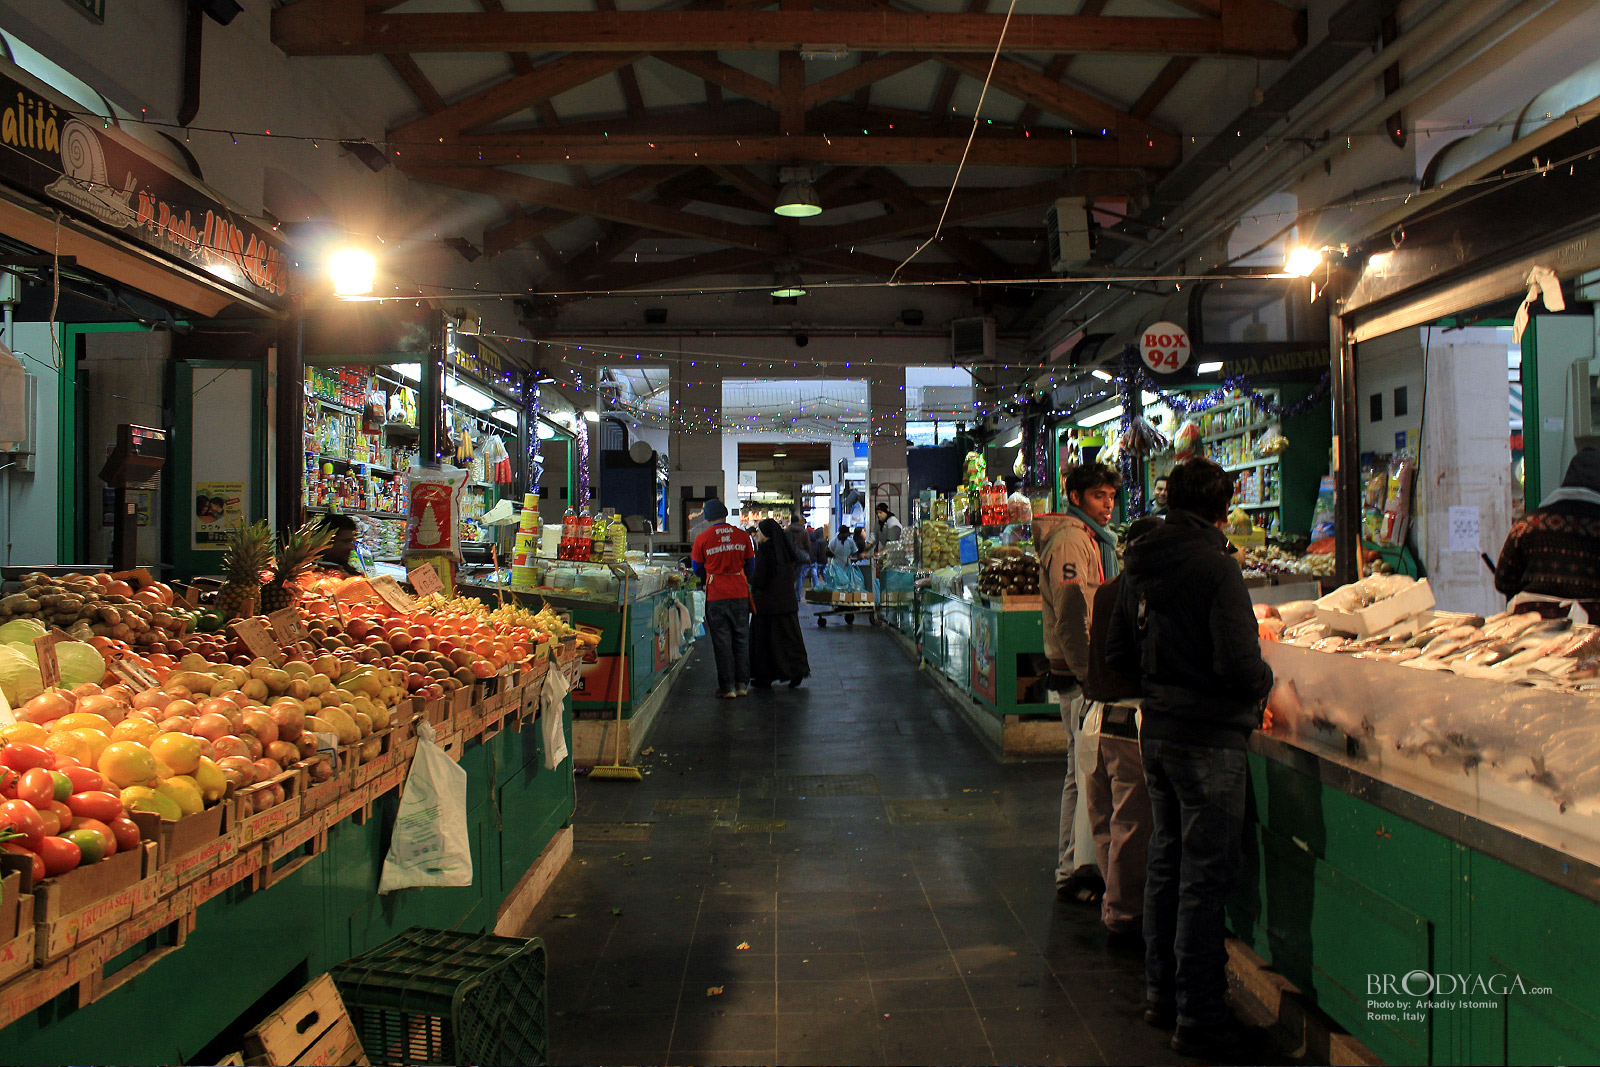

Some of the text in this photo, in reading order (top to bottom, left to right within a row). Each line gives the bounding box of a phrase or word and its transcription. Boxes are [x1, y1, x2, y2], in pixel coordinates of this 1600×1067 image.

[1145, 333, 1187, 348] BOX
[1147, 349, 1179, 370] 94
[1062, 563, 1077, 580] S
[81, 900, 114, 930] FRUTTA
